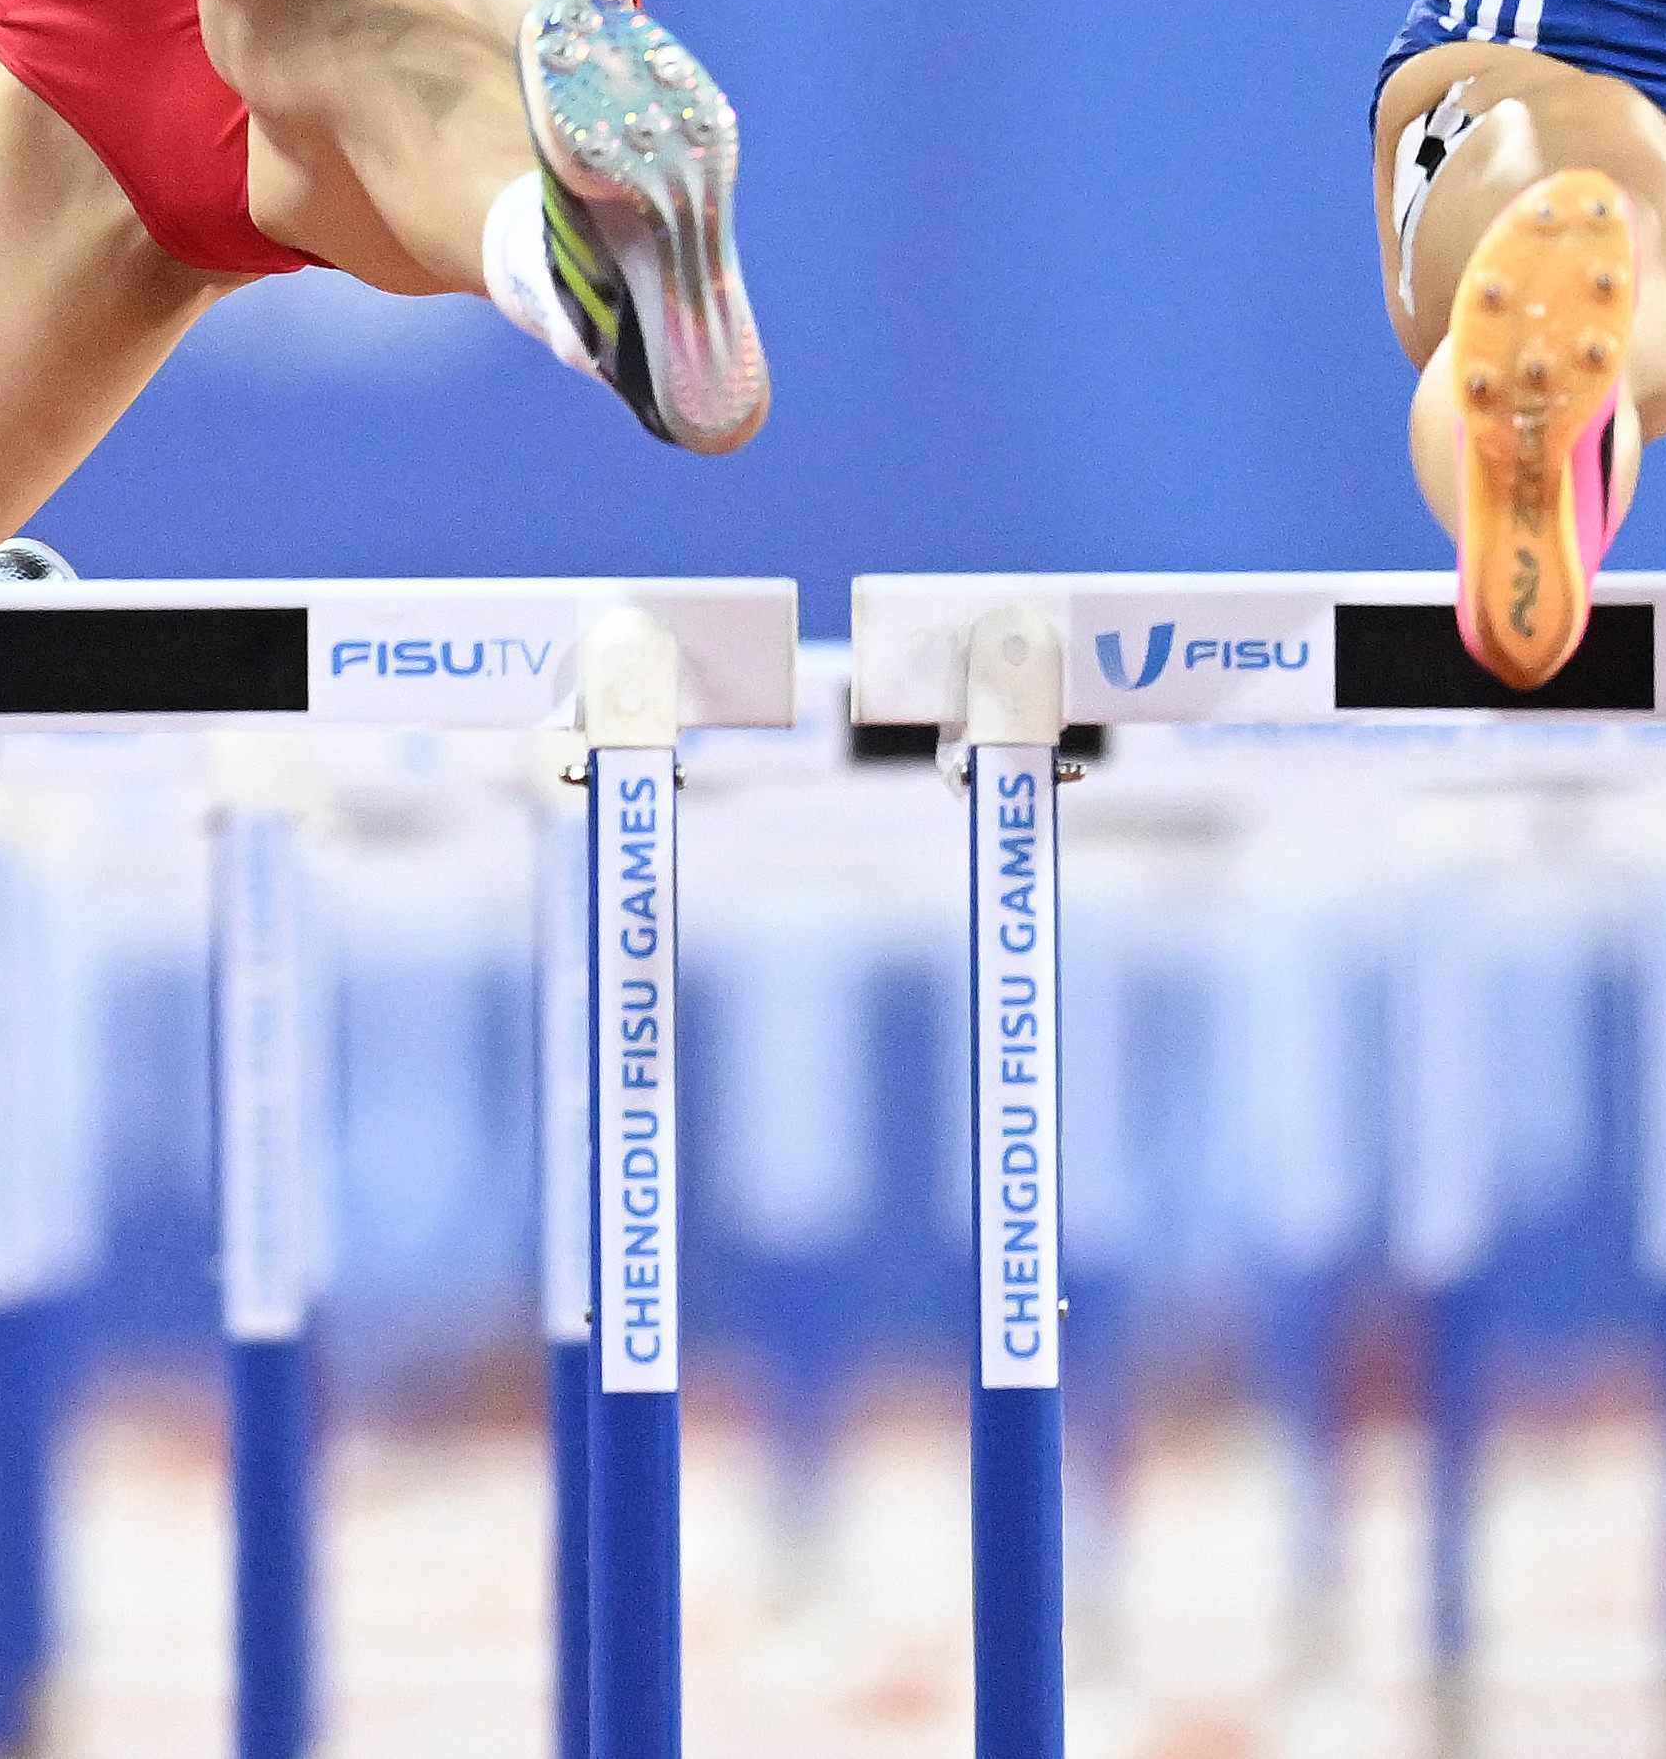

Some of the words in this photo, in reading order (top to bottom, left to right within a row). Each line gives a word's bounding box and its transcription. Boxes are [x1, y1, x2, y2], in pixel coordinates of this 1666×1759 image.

[331, 639, 551, 678] FISU.TV
[1184, 639, 1310, 671] FISU
[619, 776, 659, 960] GAMES
[997, 772, 1038, 956] GAMES
[621, 979, 659, 1090] FISU
[999, 975, 1039, 1086] FISU
[622, 1109, 662, 1365] CHENGDU
[1001, 1104, 1041, 1361] CHENGDU
